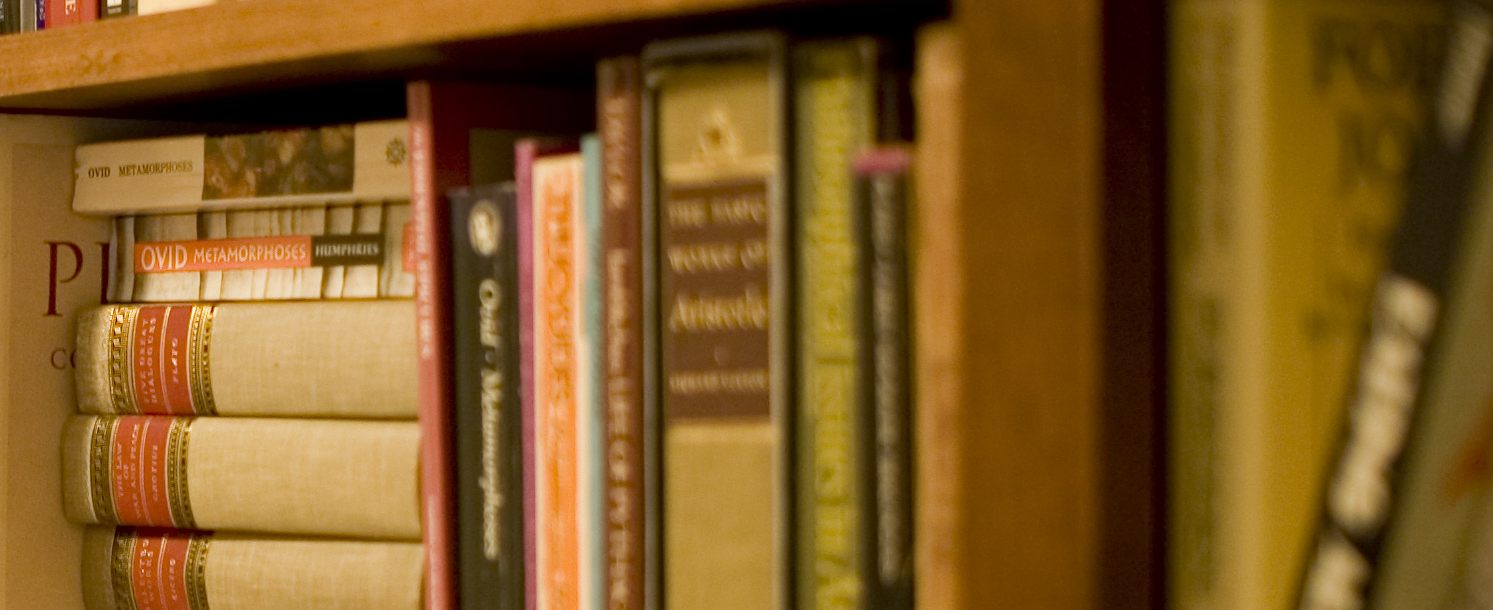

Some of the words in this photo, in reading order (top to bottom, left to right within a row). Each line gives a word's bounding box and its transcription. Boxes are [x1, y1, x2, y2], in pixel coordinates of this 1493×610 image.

[88, 166, 111, 178] OVID
[118, 161, 194, 177] METAMORPHOSES
[140, 244, 188, 271] OVID
[193, 242, 307, 265] METAMORPHOSES
[314, 242, 380, 258] HUMPHRIES
[146, 317, 157, 404] DIALOGUES
[170, 337, 179, 385] PLATO
[115, 442, 123, 471] LAW
